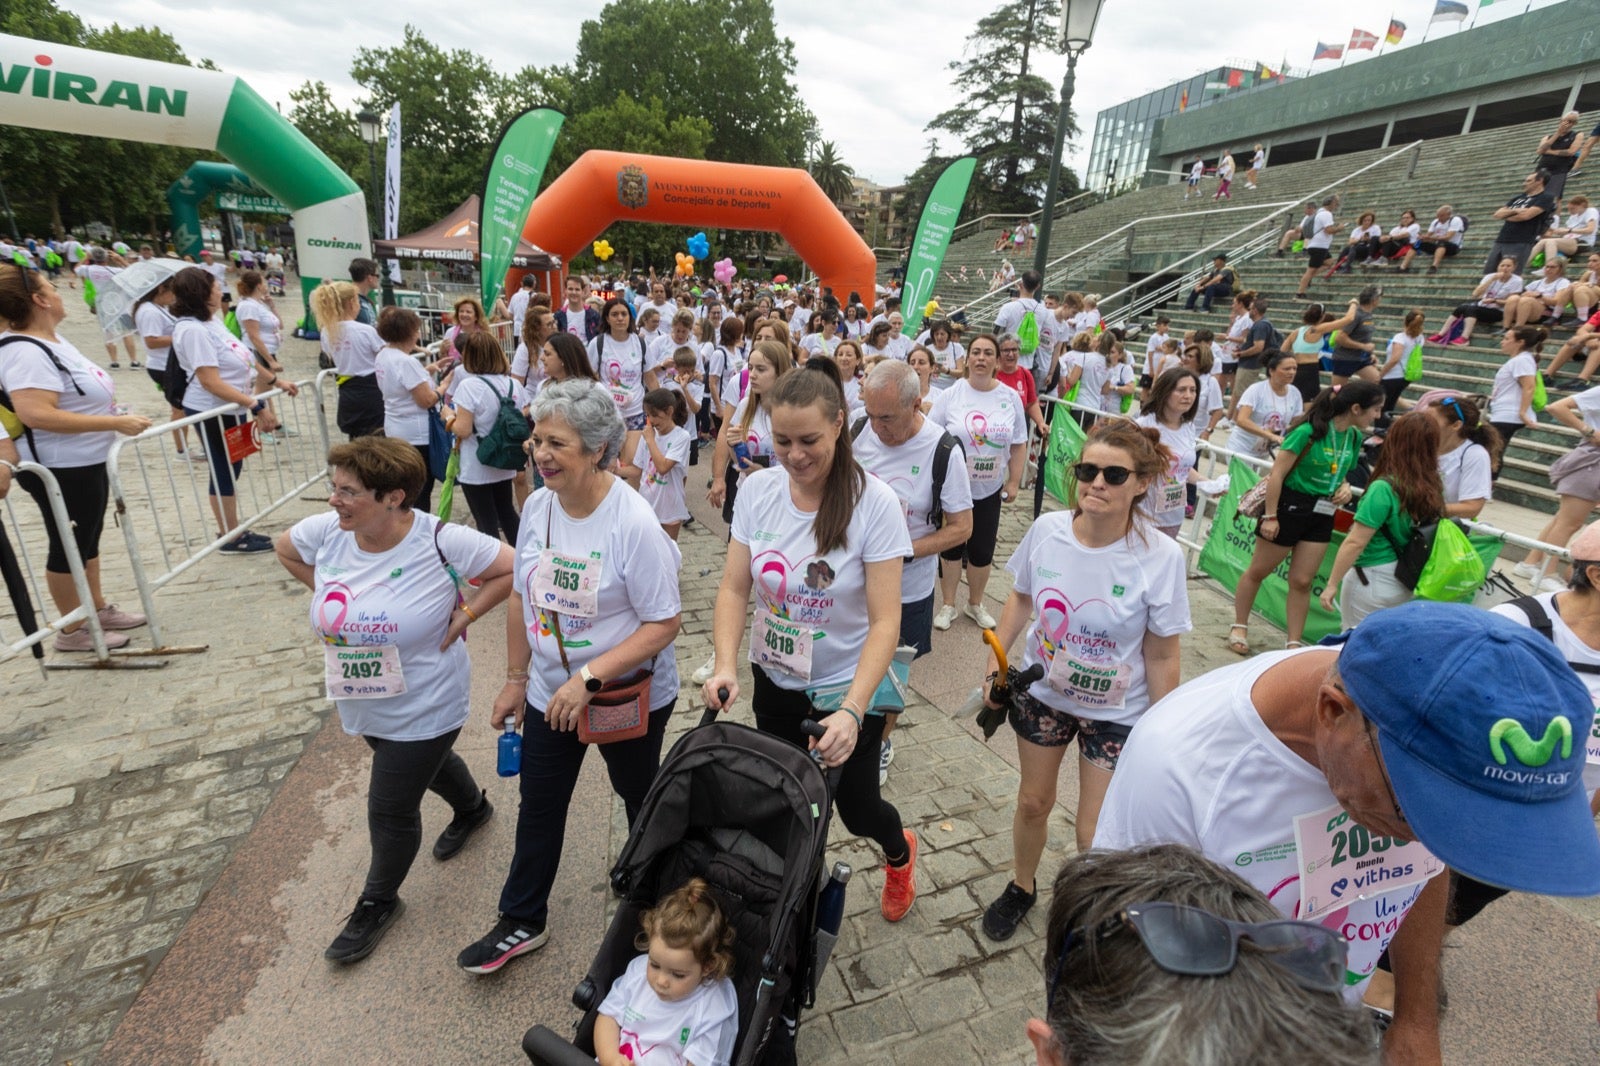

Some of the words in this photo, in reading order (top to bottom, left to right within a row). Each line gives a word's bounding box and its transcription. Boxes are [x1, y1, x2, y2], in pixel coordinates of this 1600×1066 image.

[653, 181, 723, 195] AYUNTAMIENTO
[726, 187, 737, 196] DE
[716, 198, 729, 207] de
[731, 199, 772, 210] Deportes
[973, 461, 994, 471] 4848
[798, 583, 810, 595] Un
[786, 592, 834, 609] corazón
[358, 611, 370, 622] Un
[372, 610, 389, 622] solo
[343, 621, 399, 634] corazón
[1080, 624, 1092, 636] Un
[360, 634, 388, 644] 5415
[764, 628, 795, 655] 4818
[1080, 645, 1105, 656] 5415
[341, 661, 383, 679] 2492
[1069, 671, 1112, 692] 4819
[356, 685, 387, 694] vithas
[1076, 693, 1108, 704] vithas
[1484, 765, 1572, 785] movistar
[1330, 824, 1412, 867] 205
[1355, 856, 1385, 870] Abuelo
[1353, 863, 1414, 889] vithas
[1375, 896, 1400, 919] Un
[1401, 884, 1421, 910] sol
